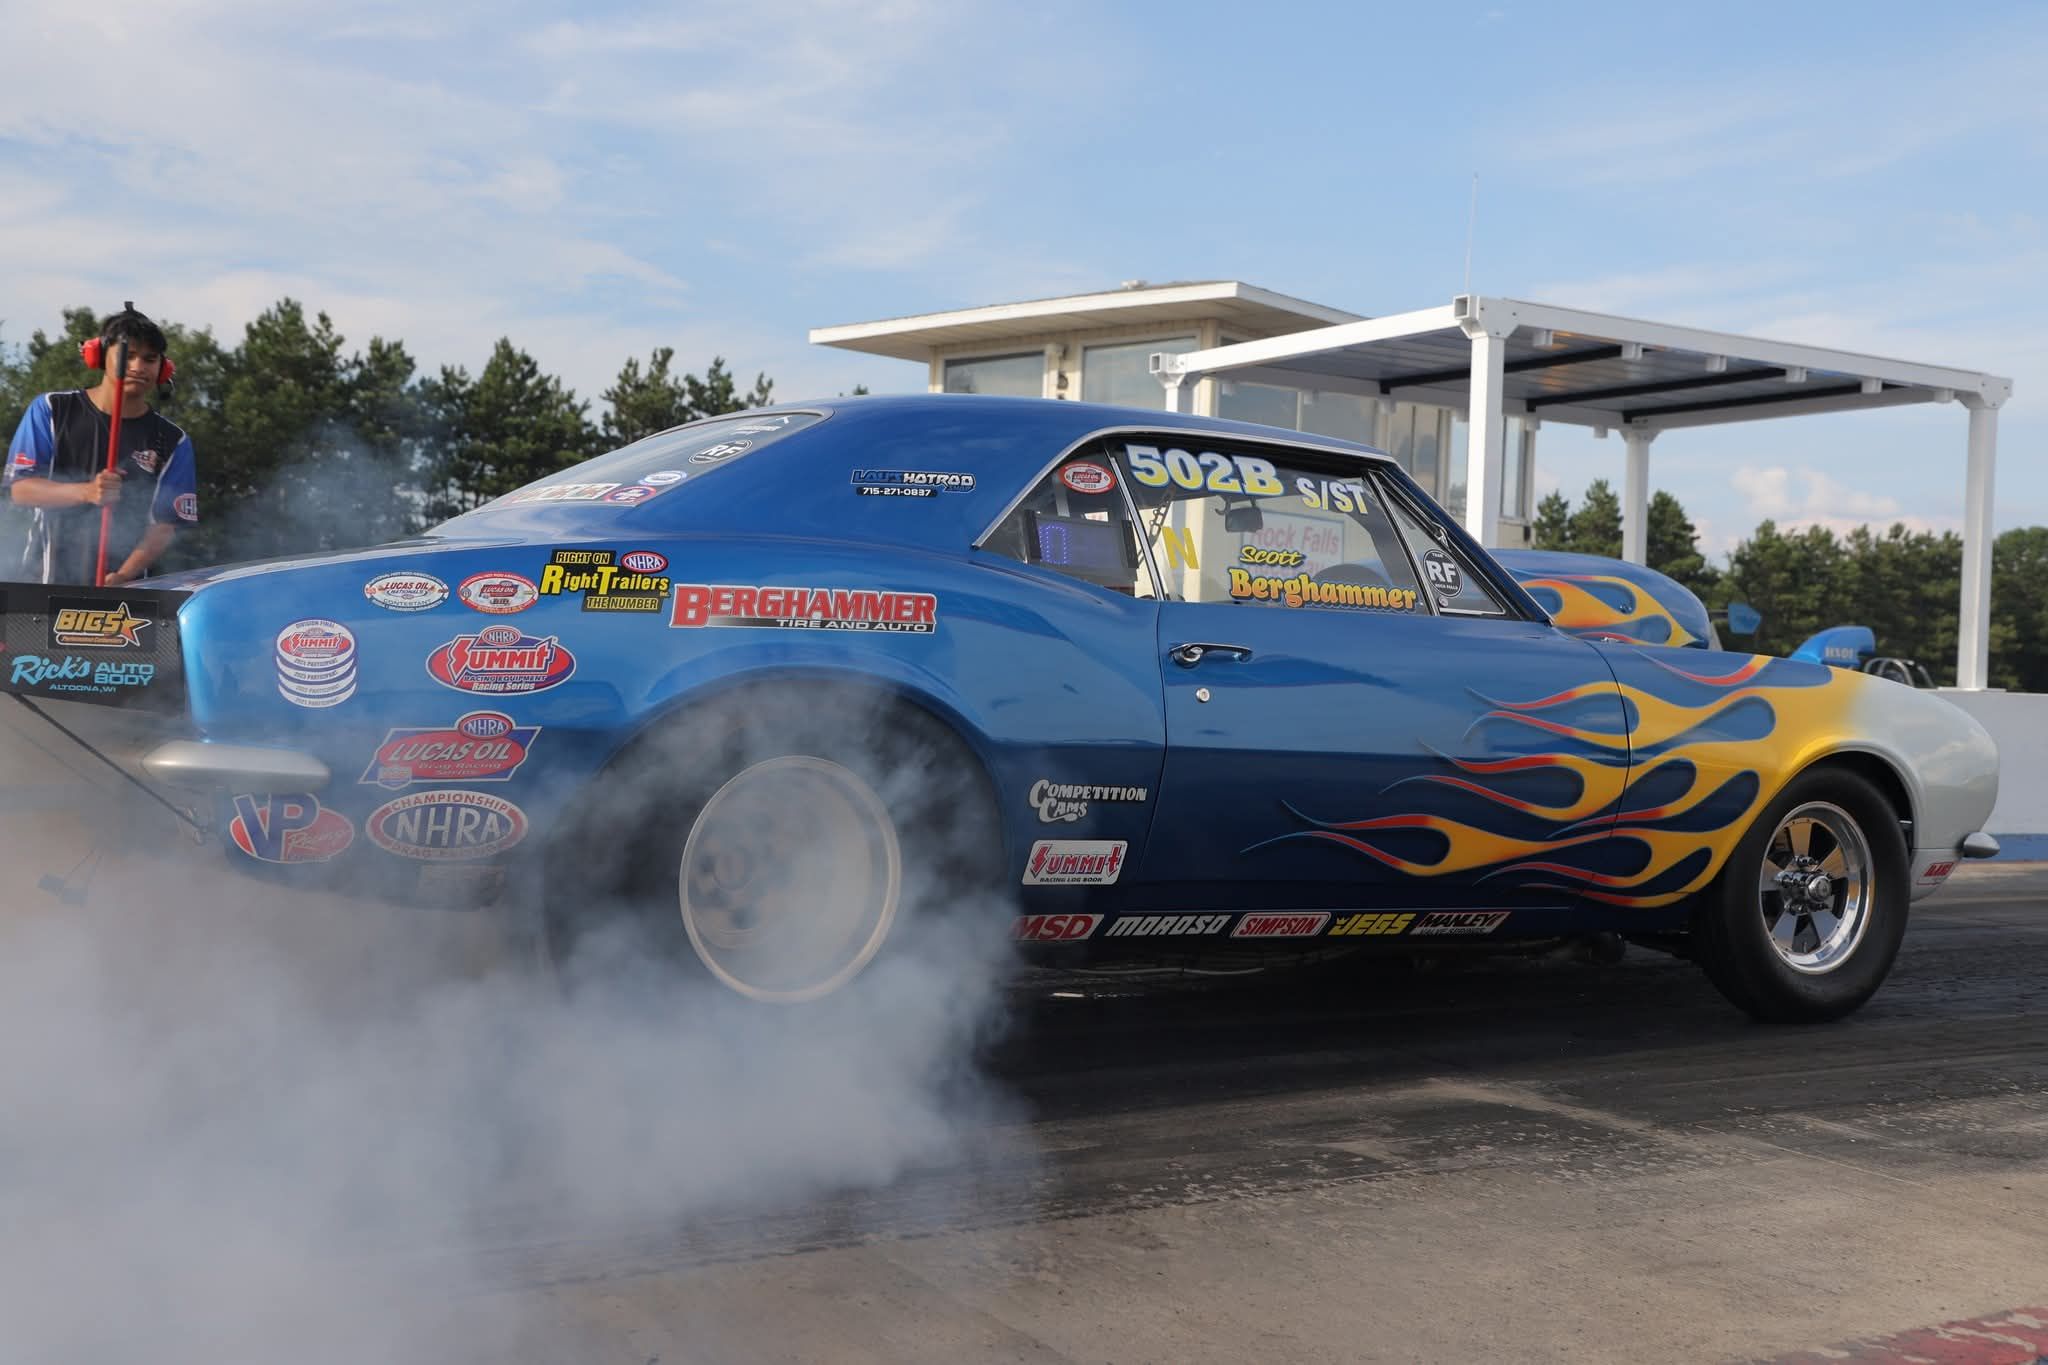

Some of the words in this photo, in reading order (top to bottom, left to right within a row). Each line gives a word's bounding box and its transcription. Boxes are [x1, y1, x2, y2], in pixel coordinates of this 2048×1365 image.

[903, 472, 974, 486] HOTROD
[1125, 444, 1284, 496] 502B
[1296, 476, 1368, 515] S/ST
[1162, 526, 1199, 569] N
[1302, 526, 1340, 554] Falls
[556, 551, 591, 563] RIGHT
[593, 552, 610, 564] ON
[628, 555, 661, 569] NHRA
[1239, 546, 1303, 566] Scott
[1426, 560, 1456, 583] RF
[384, 582, 414, 590] LUCAS
[415, 582, 429, 590] OIL
[1228, 568, 1416, 608] Berghammer
[587, 596, 609, 609] THE
[610, 596, 658, 610] NUMBER
[669, 584, 936, 628] BERGHAMMER
[776, 619, 825, 629] TIRE
[826, 620, 870, 631] AND
[873, 622, 927, 632] AUTO
[490, 632, 514, 643] NHRA
[10, 655, 91, 685] Rick's
[95, 662, 154, 675] AUTO
[94, 674, 153, 686] BODY
[471, 682, 504, 692] Racing
[505, 682, 535, 690] Series
[467, 719, 505, 735] NHRA
[388, 743, 472, 760] LUCAS
[474, 743, 512, 760] OIL
[390, 793, 508, 812] CHAMPIONSHIP
[1030, 779, 1147, 808] COMPETITION
[1039, 798, 1087, 822] CAMS
[232, 793, 320, 861] VP
[395, 806, 502, 847] NHRA
[1013, 915, 1094, 939] MSD
[1104, 915, 1232, 936] MOROSO
[1240, 916, 1320, 935] SIMPSON
[1327, 913, 1417, 936] JEGS
